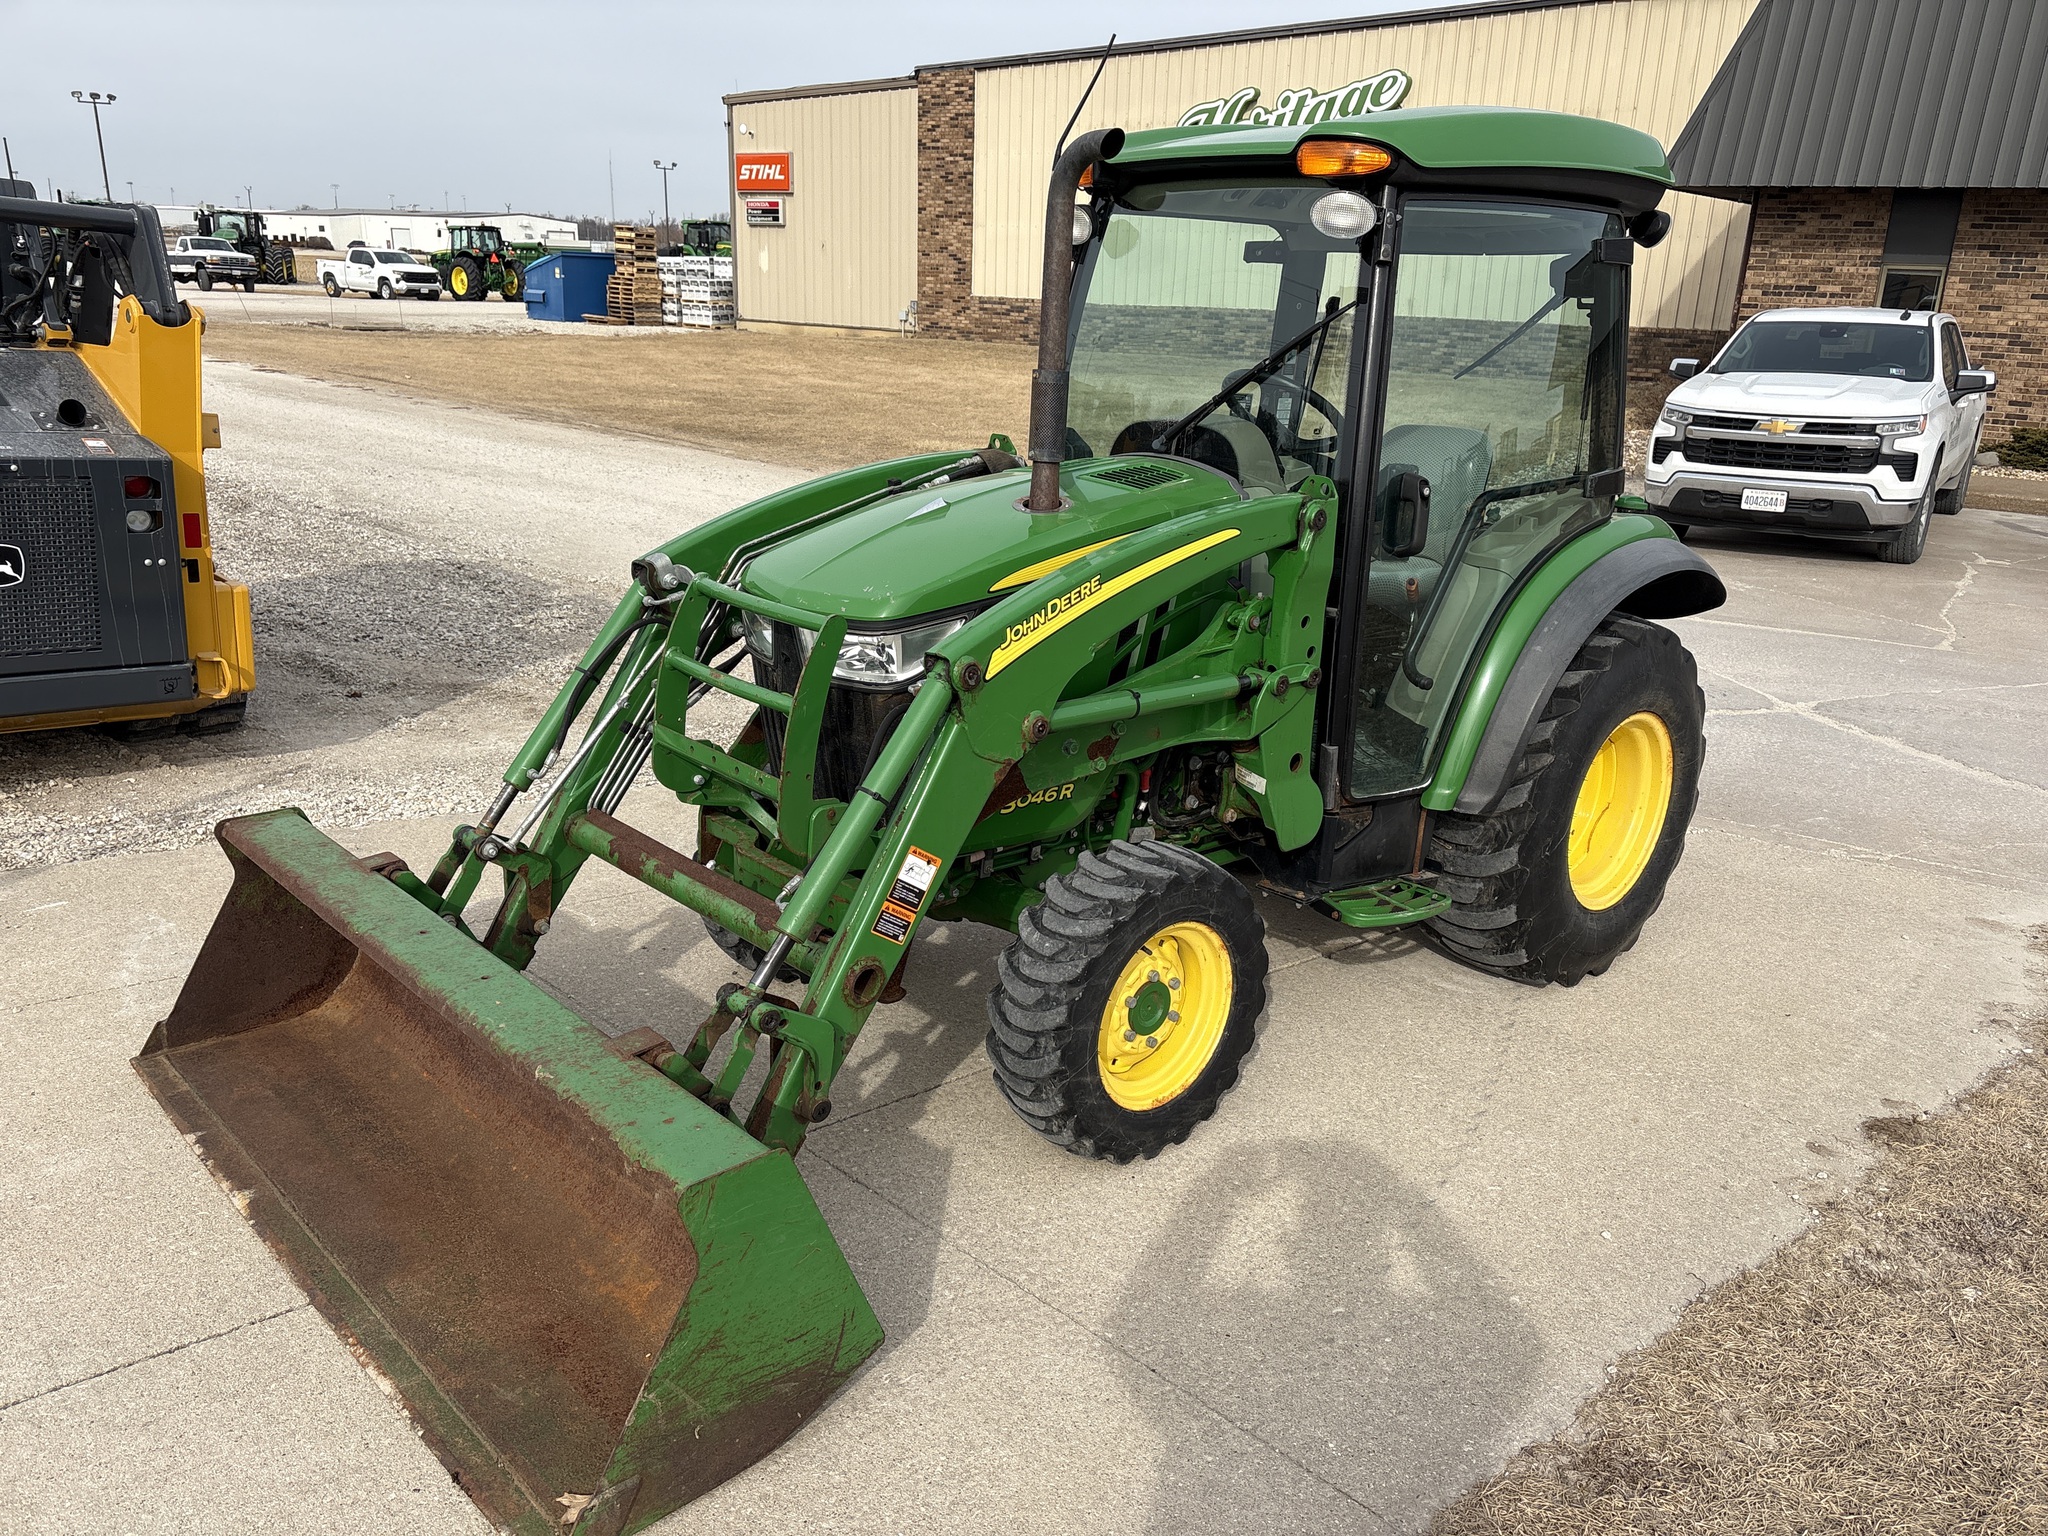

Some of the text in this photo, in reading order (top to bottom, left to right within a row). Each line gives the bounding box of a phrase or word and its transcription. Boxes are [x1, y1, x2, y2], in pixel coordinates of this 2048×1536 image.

[1178, 69, 1412, 127] Hritage
[739, 164, 785, 180] STIHL
[1744, 495, 1779, 508] 4042644
[1000, 574, 1103, 650] JOHN DEERE
[891, 907, 912, 920] WARNING
